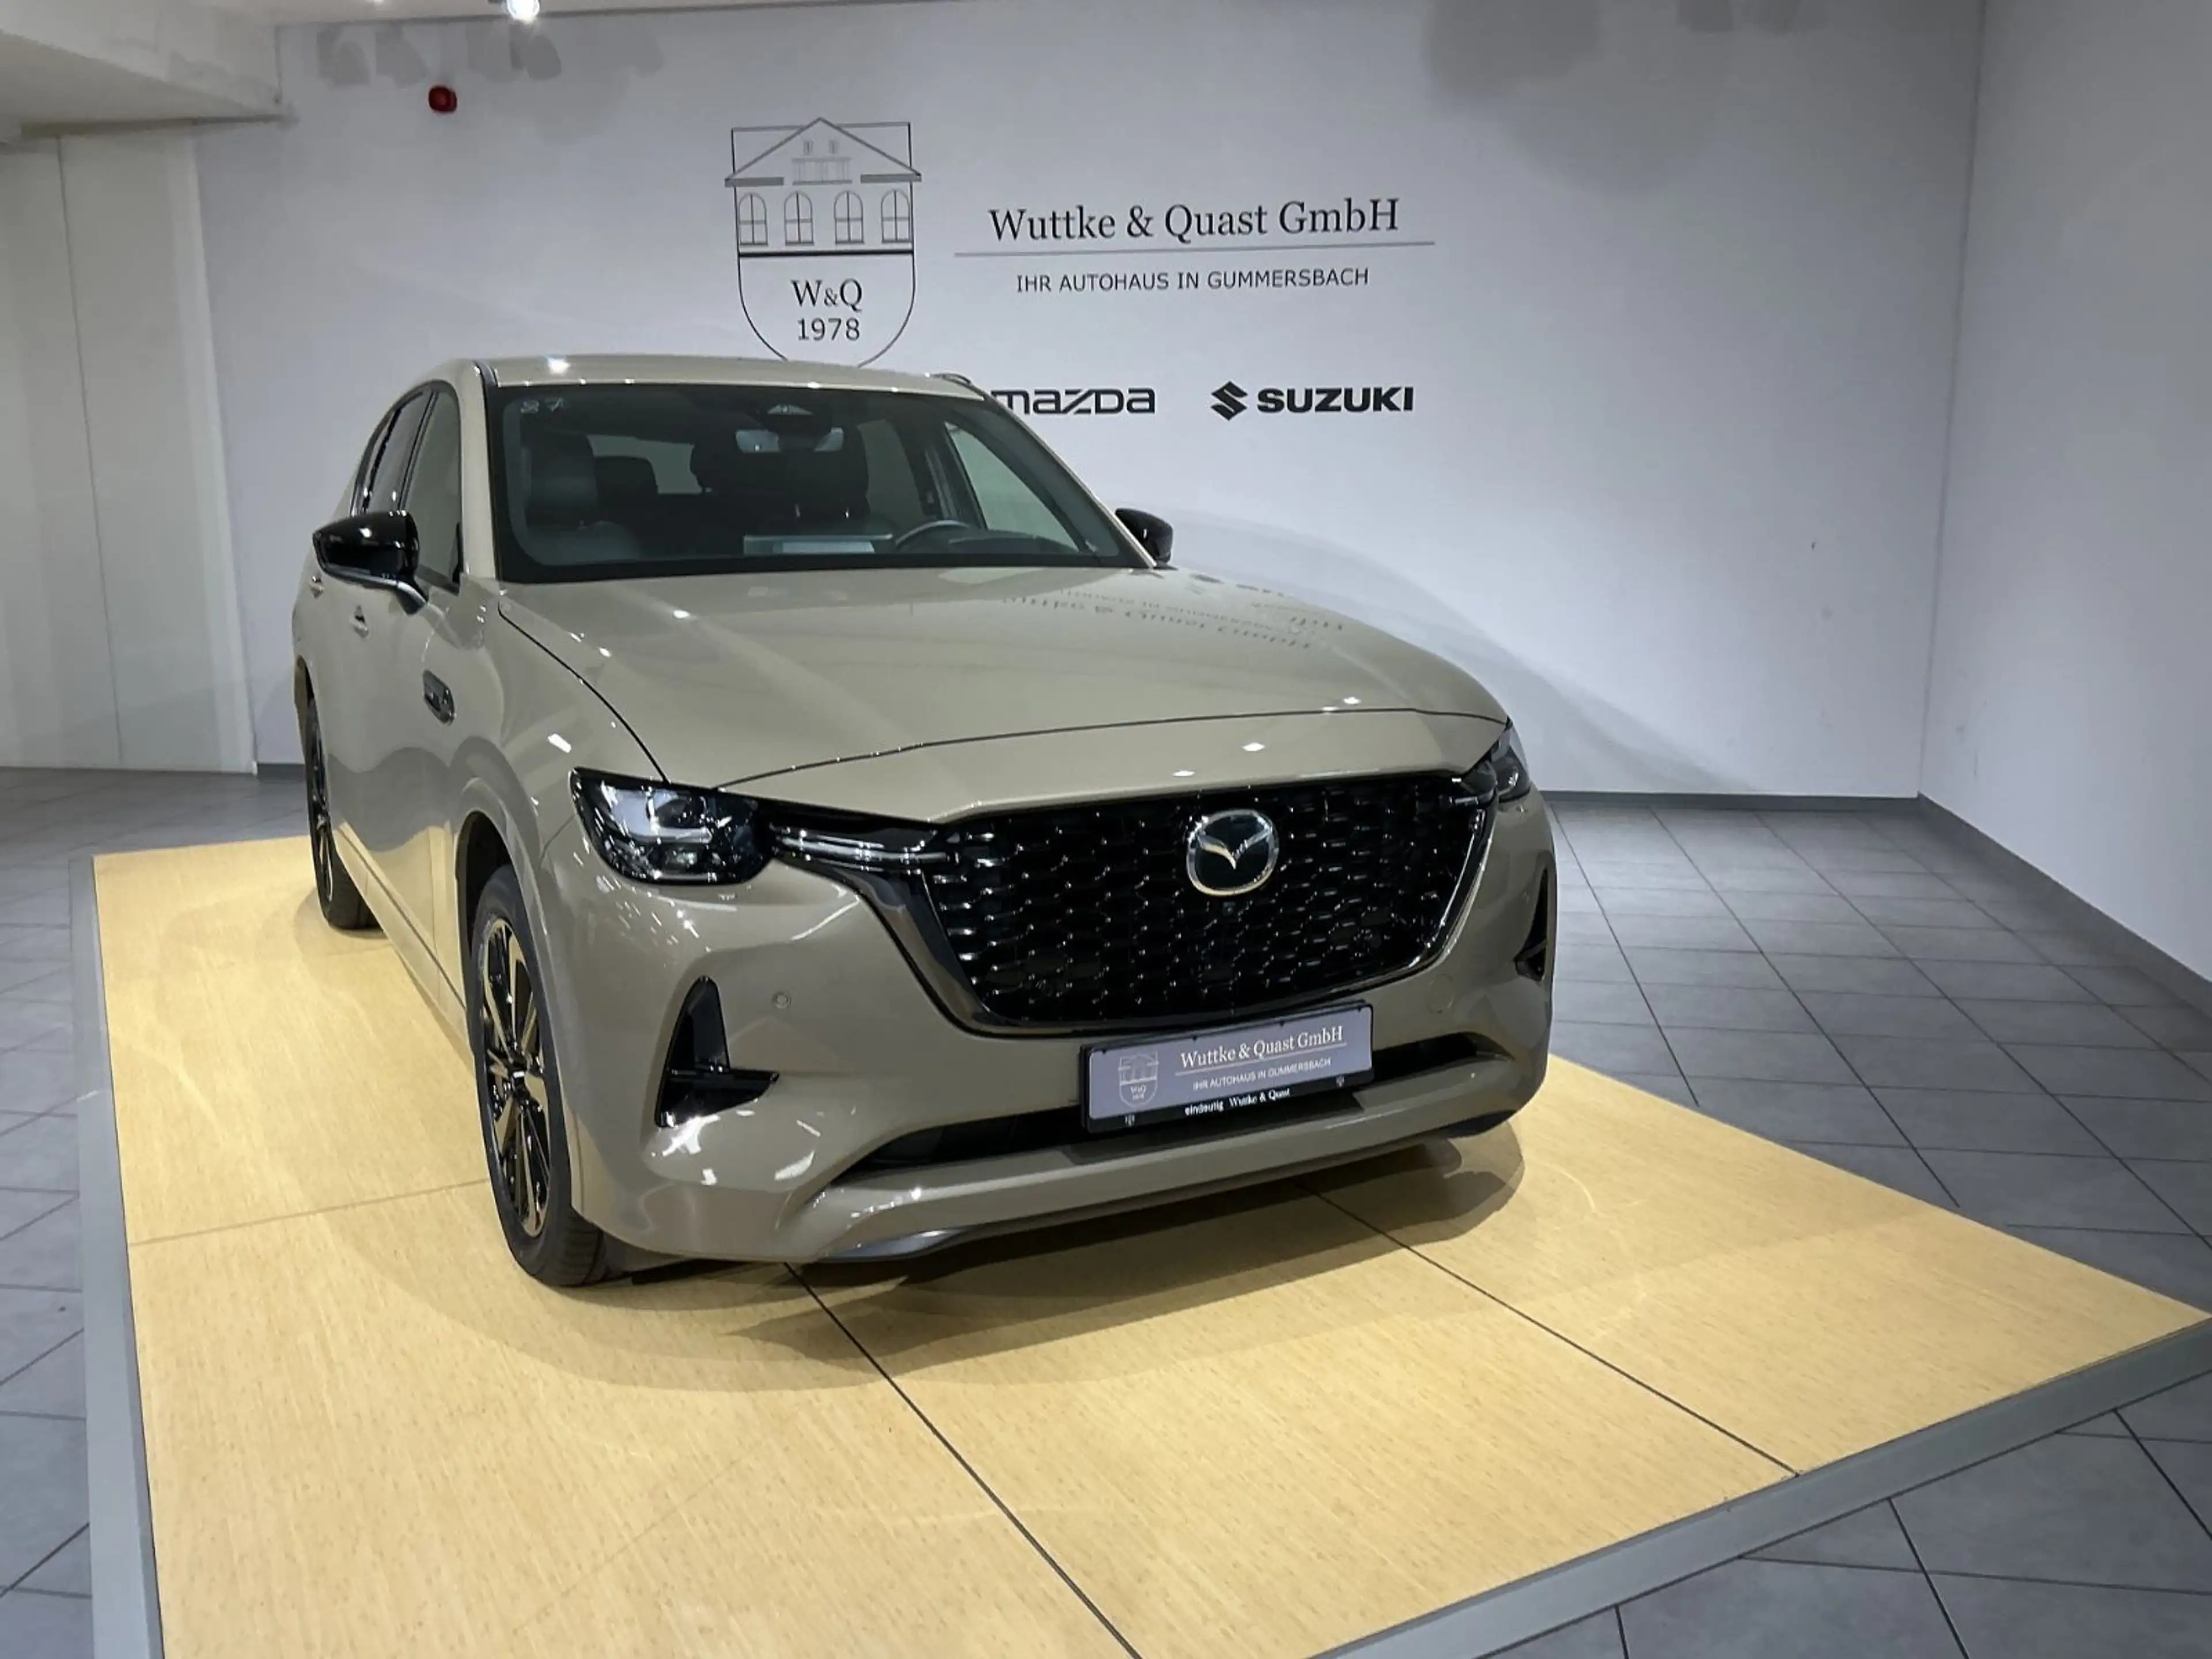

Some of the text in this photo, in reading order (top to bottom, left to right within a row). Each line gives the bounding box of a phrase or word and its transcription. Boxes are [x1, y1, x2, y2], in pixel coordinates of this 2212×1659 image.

[988, 197, 1400, 244] Wuttke & Quast GmbH
[790, 278, 863, 312] W&Q
[1017, 267, 1369, 293] IHR AUTOHAUS IN GUMMERSBACH
[797, 317, 860, 341] 1978
[1256, 387, 1414, 414] SUZUKI
[1180, 1025, 1343, 1069] Wuttke & Quast GmbH
[1192, 1057, 1331, 1090] IHR AUTOHAUS IN GUMMERSBACH
[1184, 1088, 1291, 1116] eindeutig Wuttke & Quast
